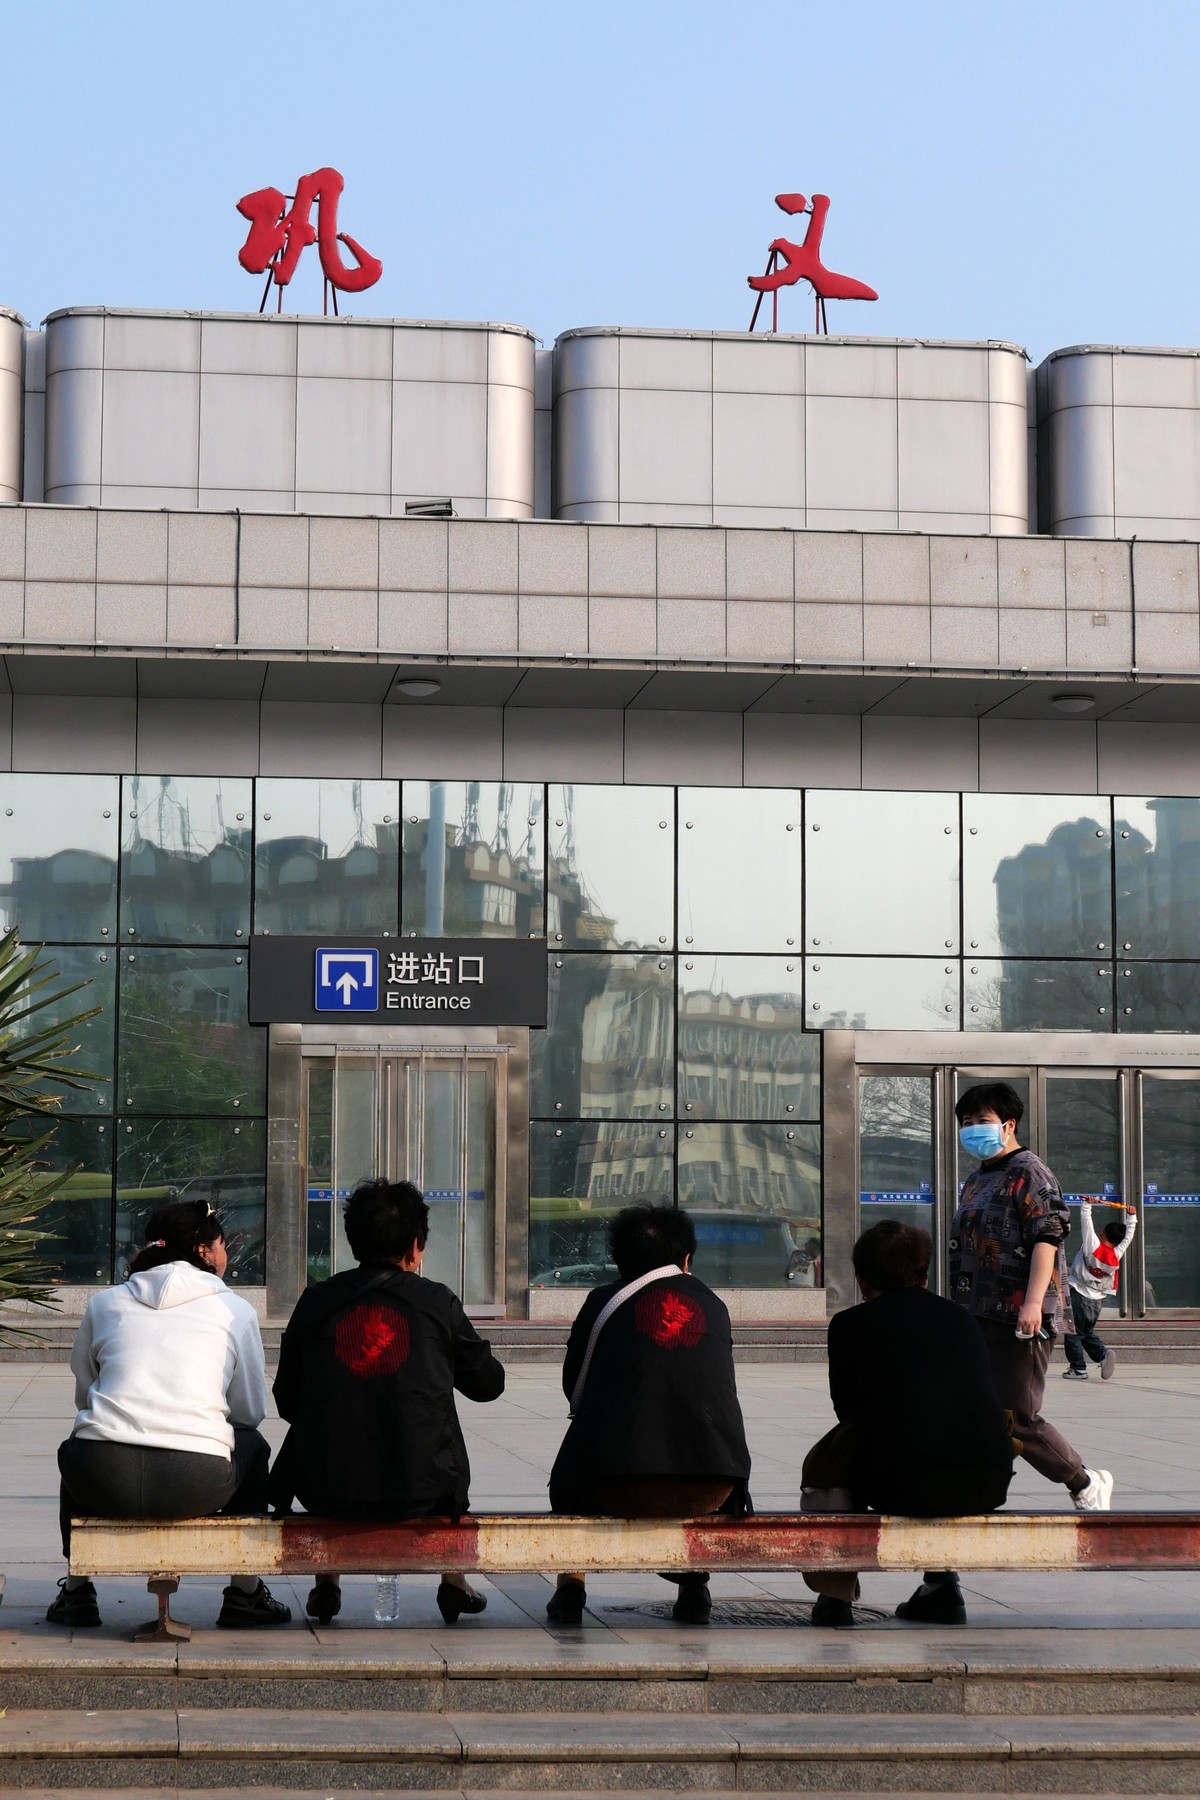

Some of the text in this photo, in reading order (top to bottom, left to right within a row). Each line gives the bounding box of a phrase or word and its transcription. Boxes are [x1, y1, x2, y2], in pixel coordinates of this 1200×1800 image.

[387, 952, 484, 984] 进站口
[386, 992, 471, 1009] Entrance
